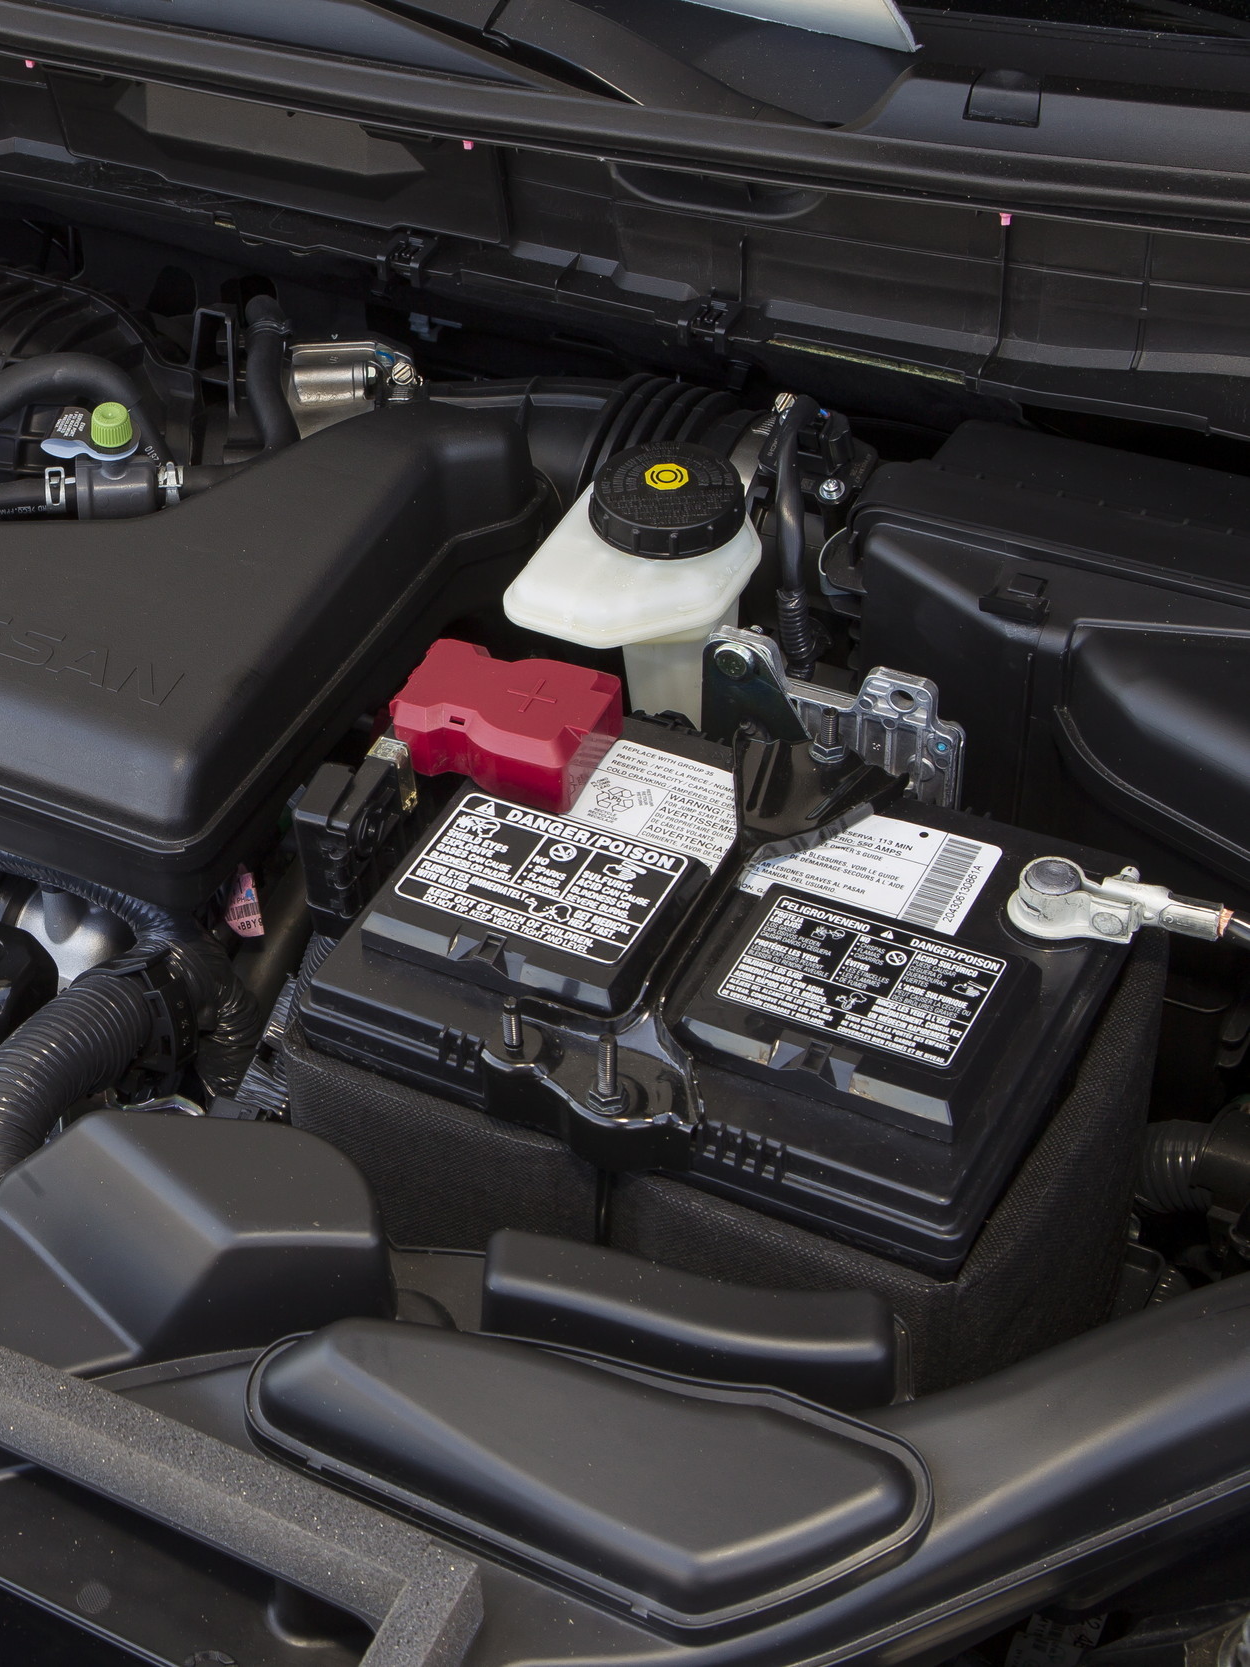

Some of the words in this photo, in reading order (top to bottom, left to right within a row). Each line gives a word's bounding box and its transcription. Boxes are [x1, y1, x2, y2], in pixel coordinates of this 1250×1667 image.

[622, 746, 657, 759] REPLACE
[657, 757, 677, 765] WITH
[677, 762, 705, 773] GROUP
[606, 767, 627, 775] COLD
[628, 774, 667, 787] CRANKING
[611, 761, 646, 773] RESERVE
[646, 771, 683, 784] CAPACITY
[668, 795, 725, 815] WARNING!
[679, 806, 698, 814] JUMP
[698, 812, 718, 820] START
[658, 807, 739, 834] AVERTISSEME
[441, 836, 496, 857] EXPLOSIVE
[447, 829, 483, 845] SHIELD
[481, 840, 510, 853] EYES
[505, 810, 677, 869] DANGER/POISON
[681, 844, 702, 853] FAVOR
[875, 845, 903, 856] AMPS
[895, 843, 913, 851] MIN
[429, 851, 472, 868] BLINDNESS
[470, 864, 485, 872] OR
[482, 868, 513, 881] INJURY.
[435, 844, 469, 858] GASES
[467, 854, 486, 864] CAN
[484, 859, 512, 872] CAUSE
[532, 856, 551, 866] NO
[862, 852, 884, 861] GUIDE
[415, 869, 439, 881] WITH
[437, 876, 469, 891] WATER
[421, 861, 449, 875] FLUSH
[446, 869, 471, 882] EYES
[469, 877, 529, 901] IMMEDIATELY
[527, 873, 561, 887] FLAMES
[532, 866, 567, 880] SPARKS
[581, 871, 634, 892] SULFURIC
[762, 869, 789, 879] MANUAL
[805, 881, 837, 893] USUARIO.
[772, 865, 804, 877] LESIONES
[805, 875, 833, 885] GRAVES
[843, 885, 866, 894] PASAR
[878, 872, 899, 881] GUIDE
[570, 886, 618, 905] BLINDNESS
[615, 901, 631, 909] OR
[576, 878, 603, 891] ACID
[601, 887, 622, 897] CAN
[619, 893, 651, 906] CAUSE
[426, 887, 455, 901] KEEP
[453, 895, 478, 908] OUT
[475, 903, 492, 913] OF
[490, 908, 527, 924] REACH
[525, 919, 542, 929] OF
[540, 924, 596, 947] CHILDREN.
[565, 894, 600, 909] SEVERE
[598, 904, 631, 919] BURNS.
[773, 911, 804, 923] PROTEJA
[781, 901, 871, 932] PELIGRO/VENENO
[422, 894, 438, 903] DO
[436, 899, 456, 909] NOT
[453, 904, 471, 914] TIP.
[469, 910, 493, 921] KEEP
[492, 917, 520, 930] VENTS
[519, 926, 546, 939] TIGHT
[544, 934, 564, 945] AND
[568, 918, 592, 930] HELP
[590, 925, 619, 939] FAST.
[573, 910, 592, 921] GET
[590, 916, 633, 934] MEDICAL
[784, 921, 802, 929] OJOS
[801, 954, 820, 962] YEUX
[910, 939, 1001, 971] DANGER/POISON
[898, 983, 926, 996] L'ACIDE
[925, 991, 969, 1009] SULFURIQUE
